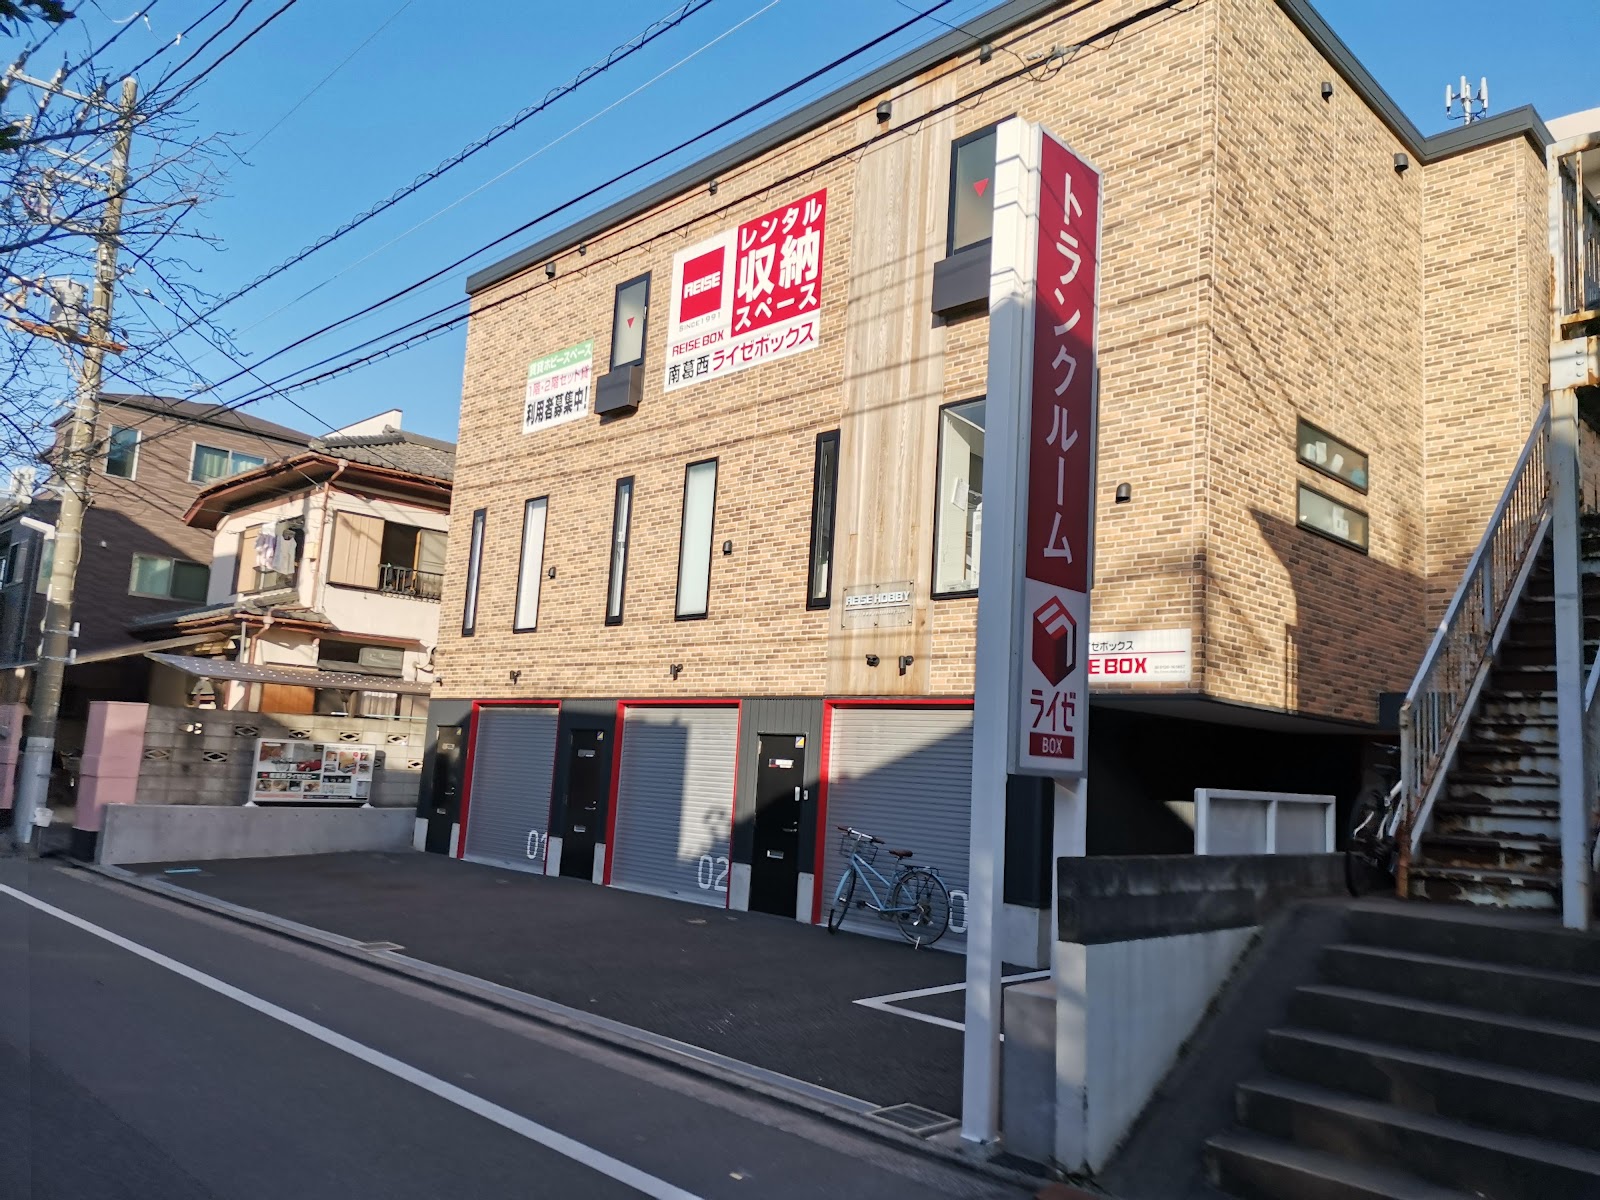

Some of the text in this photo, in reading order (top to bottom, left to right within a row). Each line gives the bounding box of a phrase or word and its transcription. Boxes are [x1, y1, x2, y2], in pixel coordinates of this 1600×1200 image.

[742, 198, 822, 251] レンタル
[737, 226, 820, 303] 収納
[684, 271, 720, 299] REISE
[735, 282, 817, 332] スペース
[672, 330, 724, 357] REISE BOX
[1043, 172, 1083, 564] トランクルーム
[1090, 640, 1134, 652] ゼボックス
[1104, 658, 1148, 674] BOX
[1031, 689, 1076, 732] ライゼ
[1042, 737, 1063, 754] BOX
[527, 830, 548, 861] 01
[698, 855, 729, 892] 02
